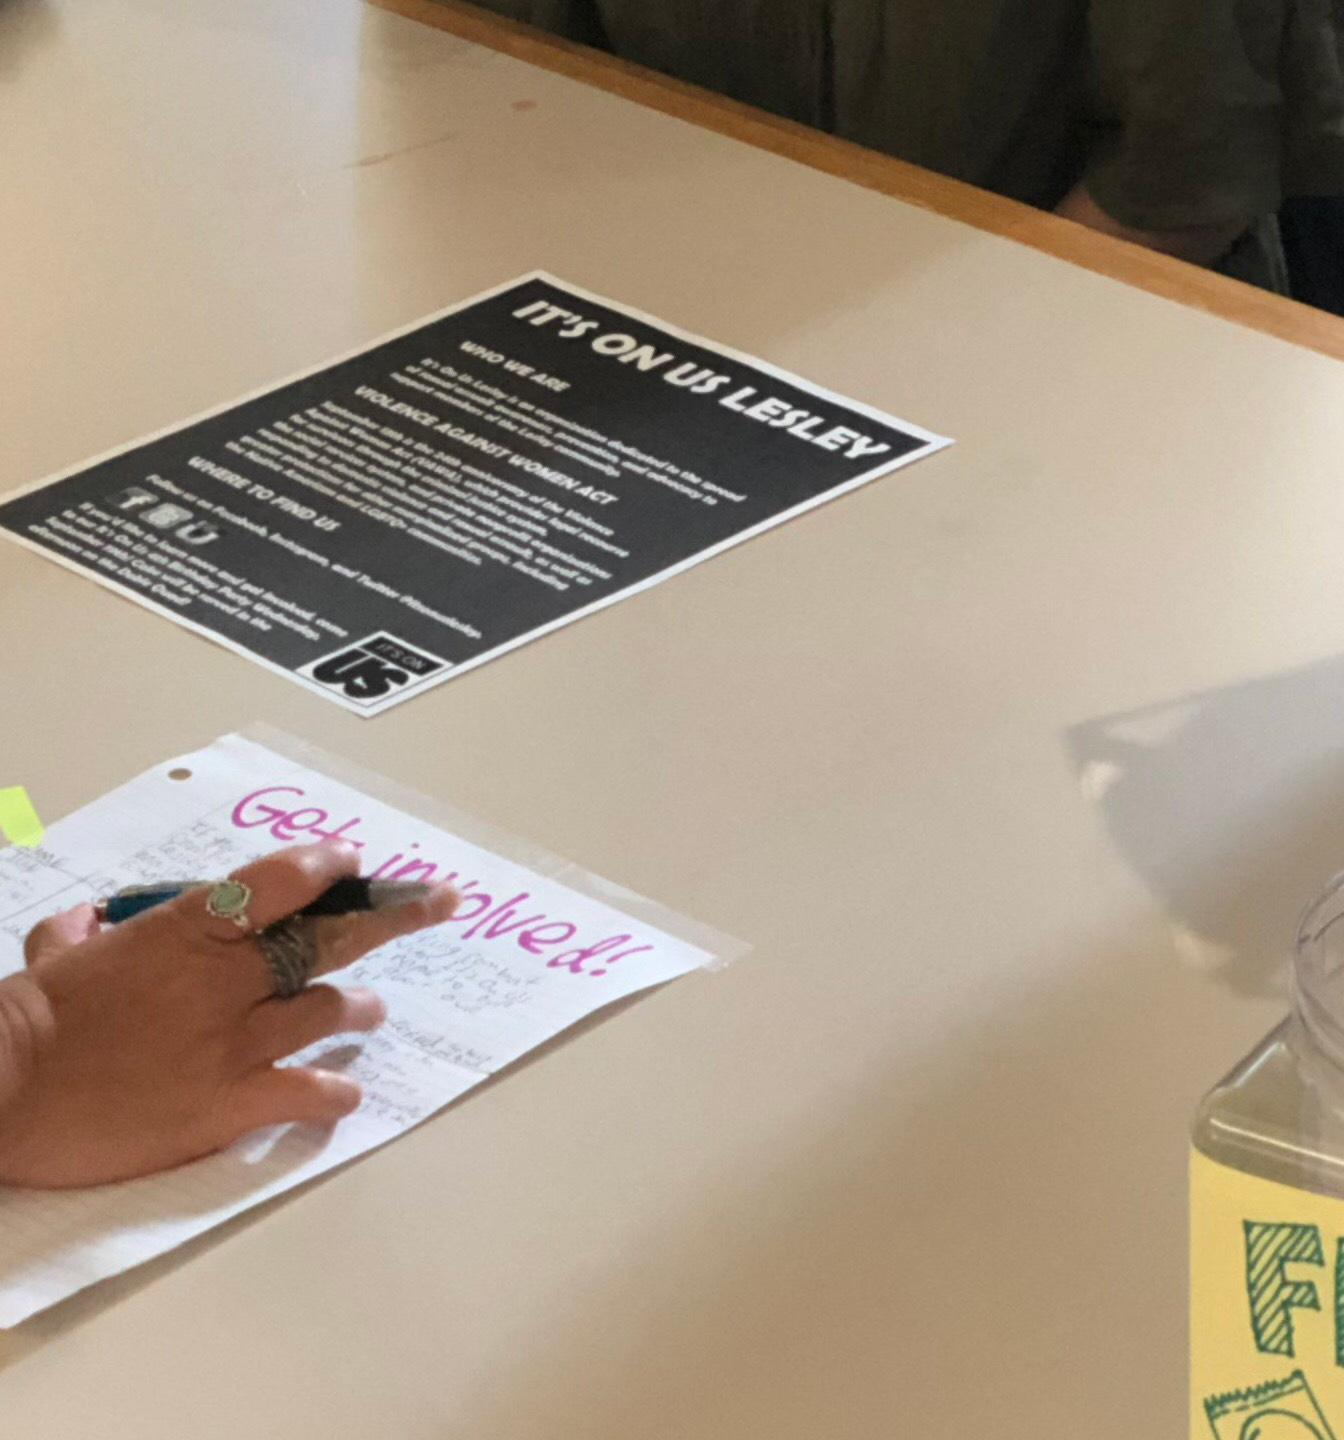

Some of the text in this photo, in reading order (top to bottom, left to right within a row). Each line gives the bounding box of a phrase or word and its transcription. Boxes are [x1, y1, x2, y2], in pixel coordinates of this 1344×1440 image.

[460, 341, 570, 392] WHO WE ARE
[513, 300, 889, 458] IT'S ON US LESLEY
[355, 386, 618, 504] VIOLENCE AGAINST WOMEN ACT
[188, 456, 341, 531] WHERE TO FIND US
[313, 649, 408, 698] US
[231, 786, 365, 848] Get
[371, 843, 654, 976] inolved!
